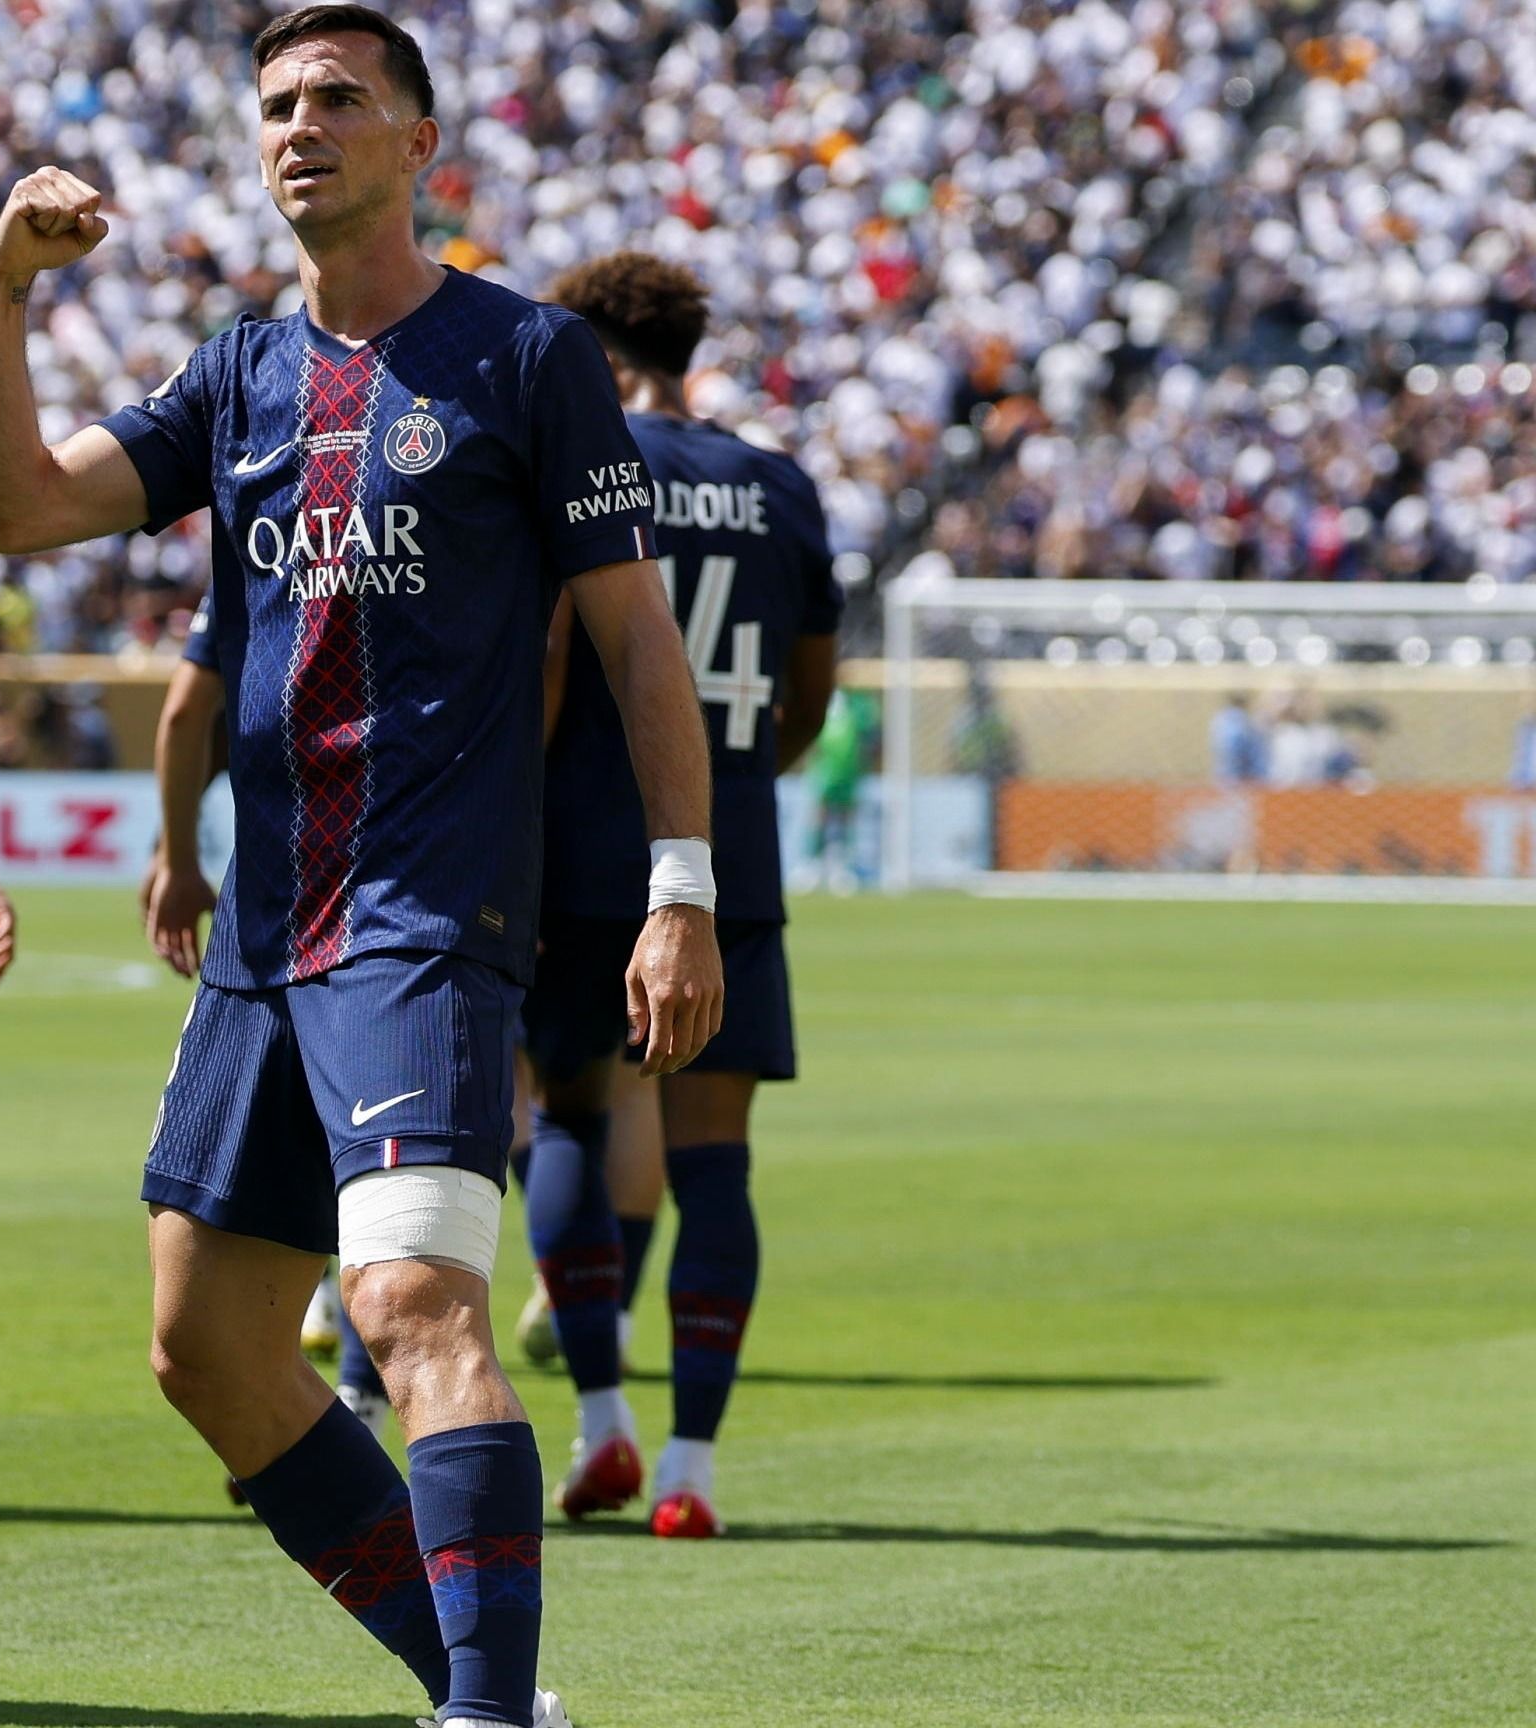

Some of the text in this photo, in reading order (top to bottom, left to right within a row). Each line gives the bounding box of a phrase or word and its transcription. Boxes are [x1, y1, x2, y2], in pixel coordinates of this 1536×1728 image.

[397, 416, 437, 433] PARIS
[588, 462, 641, 490] VISIT
[247, 504, 425, 580] QATAR
[288, 562, 427, 602] AIRWAYS
[658, 554, 774, 750] 4
